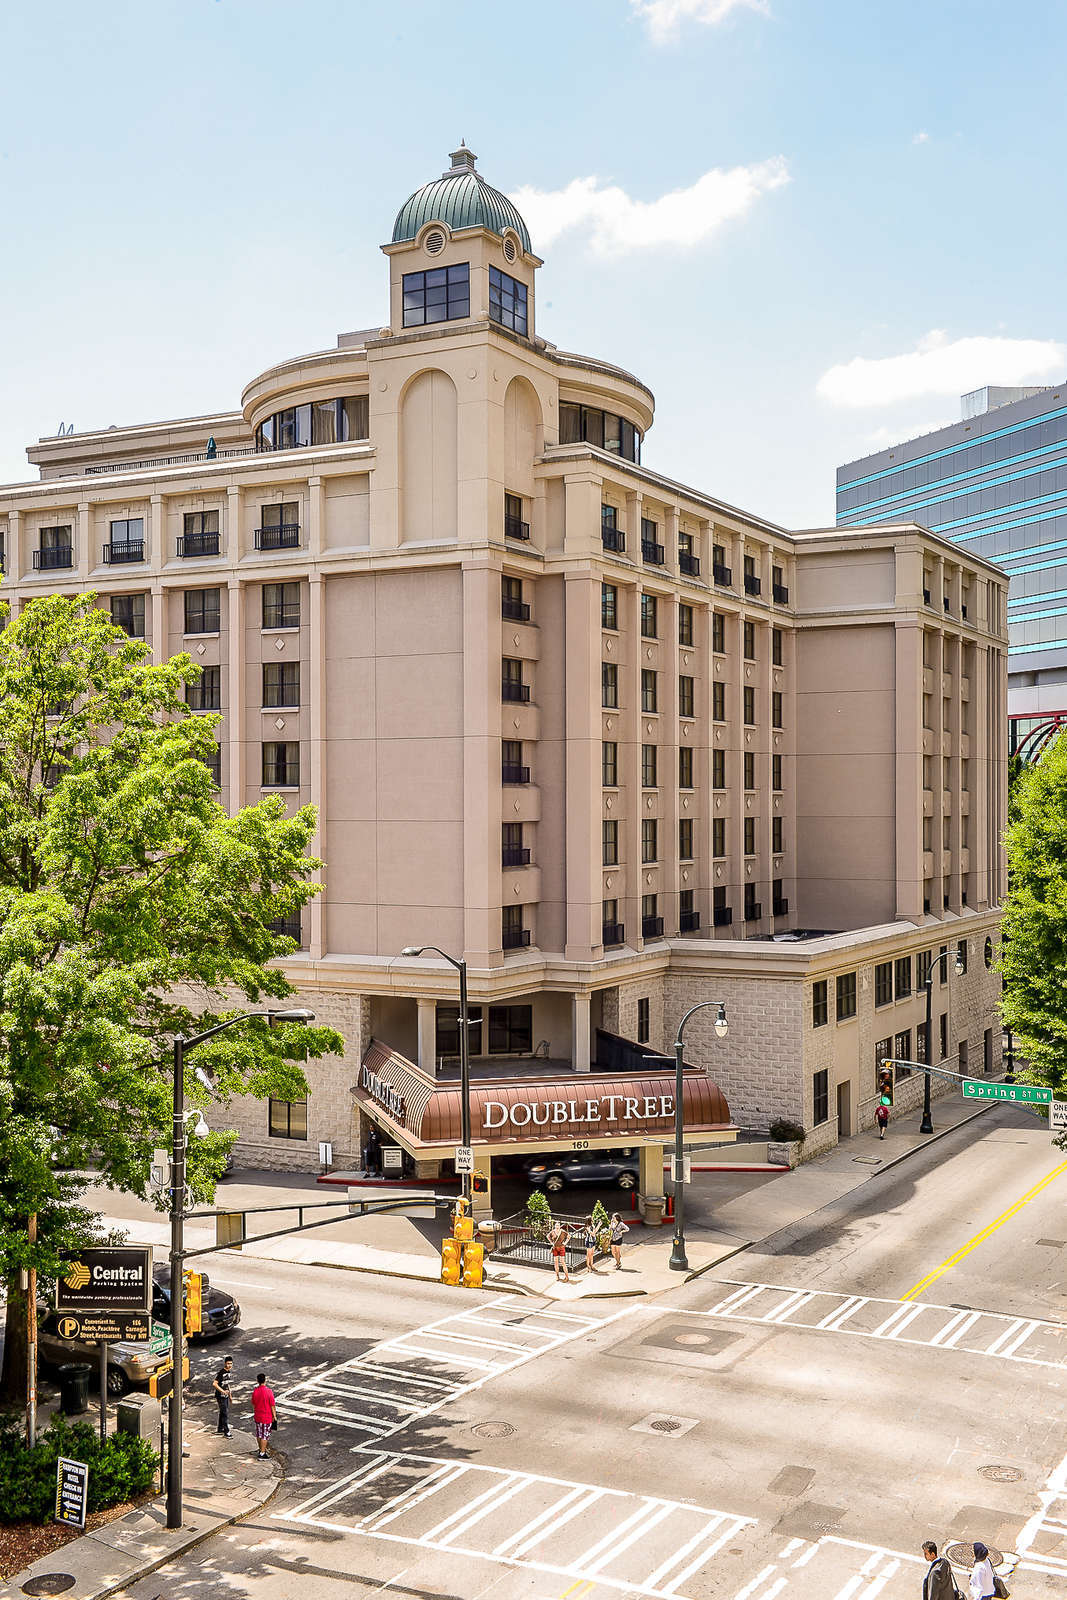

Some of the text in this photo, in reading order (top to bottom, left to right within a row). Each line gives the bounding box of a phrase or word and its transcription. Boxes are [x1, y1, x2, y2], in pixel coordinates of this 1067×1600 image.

[968, 1085, 1048, 1100] Spring ST NW
[483, 1095, 676, 1128] DOUBLETREE
[572, 1140, 589, 1149] 160
[93, 1265, 143, 1281] Central
